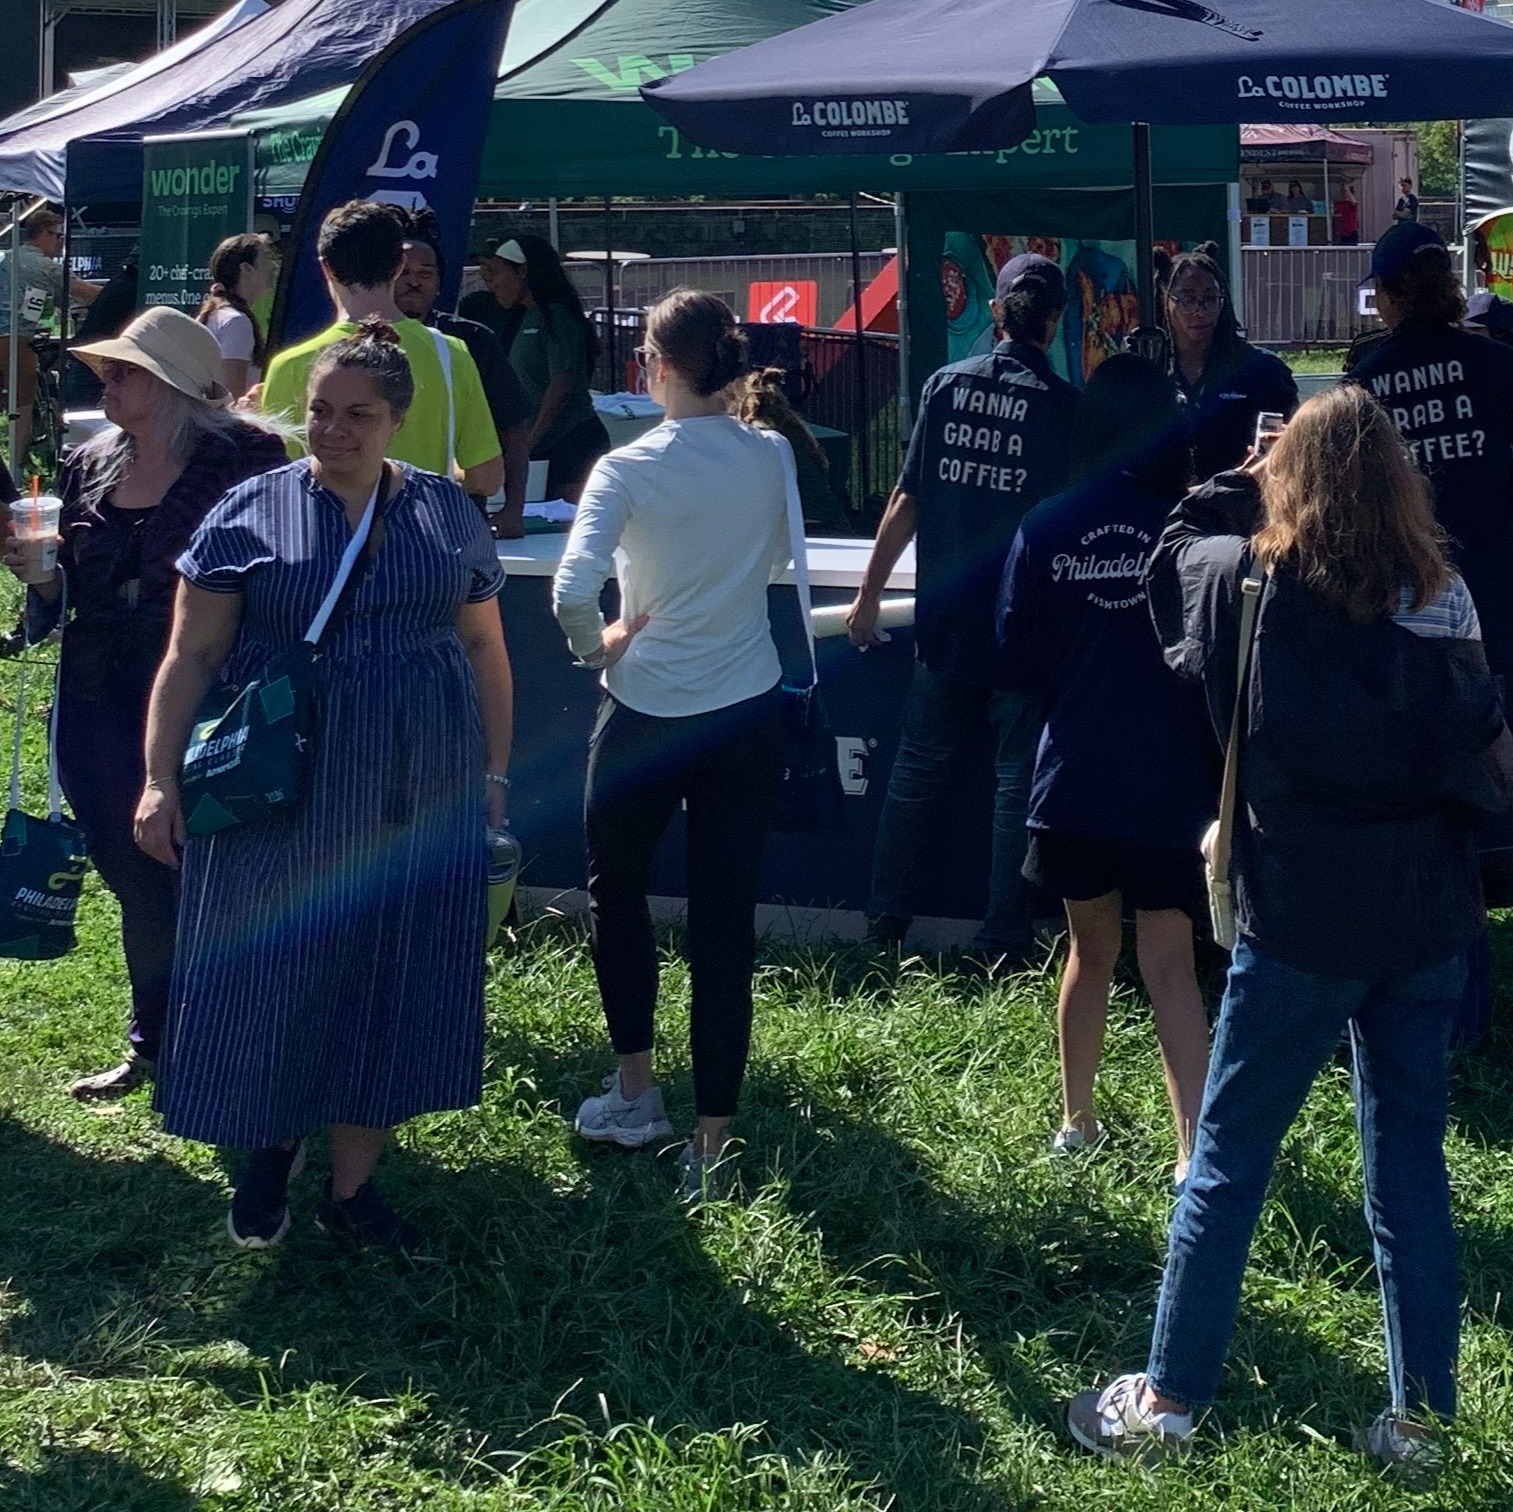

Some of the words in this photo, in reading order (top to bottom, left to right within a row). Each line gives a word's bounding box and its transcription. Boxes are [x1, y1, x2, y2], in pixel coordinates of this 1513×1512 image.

[1238, 75, 1266, 98] La
[1265, 74, 1389, 99] COLOMBE
[814, 100, 909, 126] COLOMBE
[1279, 101, 1311, 110] COFFEE
[1313, 100, 1366, 110] WORKSHOP
[366, 119, 439, 180] La
[151, 160, 241, 196] wonder
[27, 296, 44, 314] 16
[1371, 360, 1465, 398] WANNA
[952, 386, 1029, 422] WANNA
[1393, 399, 1446, 431] RAB
[1456, 395, 1473, 419] A
[944, 421, 1001, 452] GRAB
[1007, 433, 1023, 457] A
[1411, 430, 1486, 463] FFEE?
[938, 457, 1028, 493] COFFEE?
[1080, 523, 1135, 547] CRAFTED
[1137, 529, 1152, 544] IN
[1051, 551, 1151, 586] Philadelp
[1086, 591, 1148, 610] FISHTOWN
